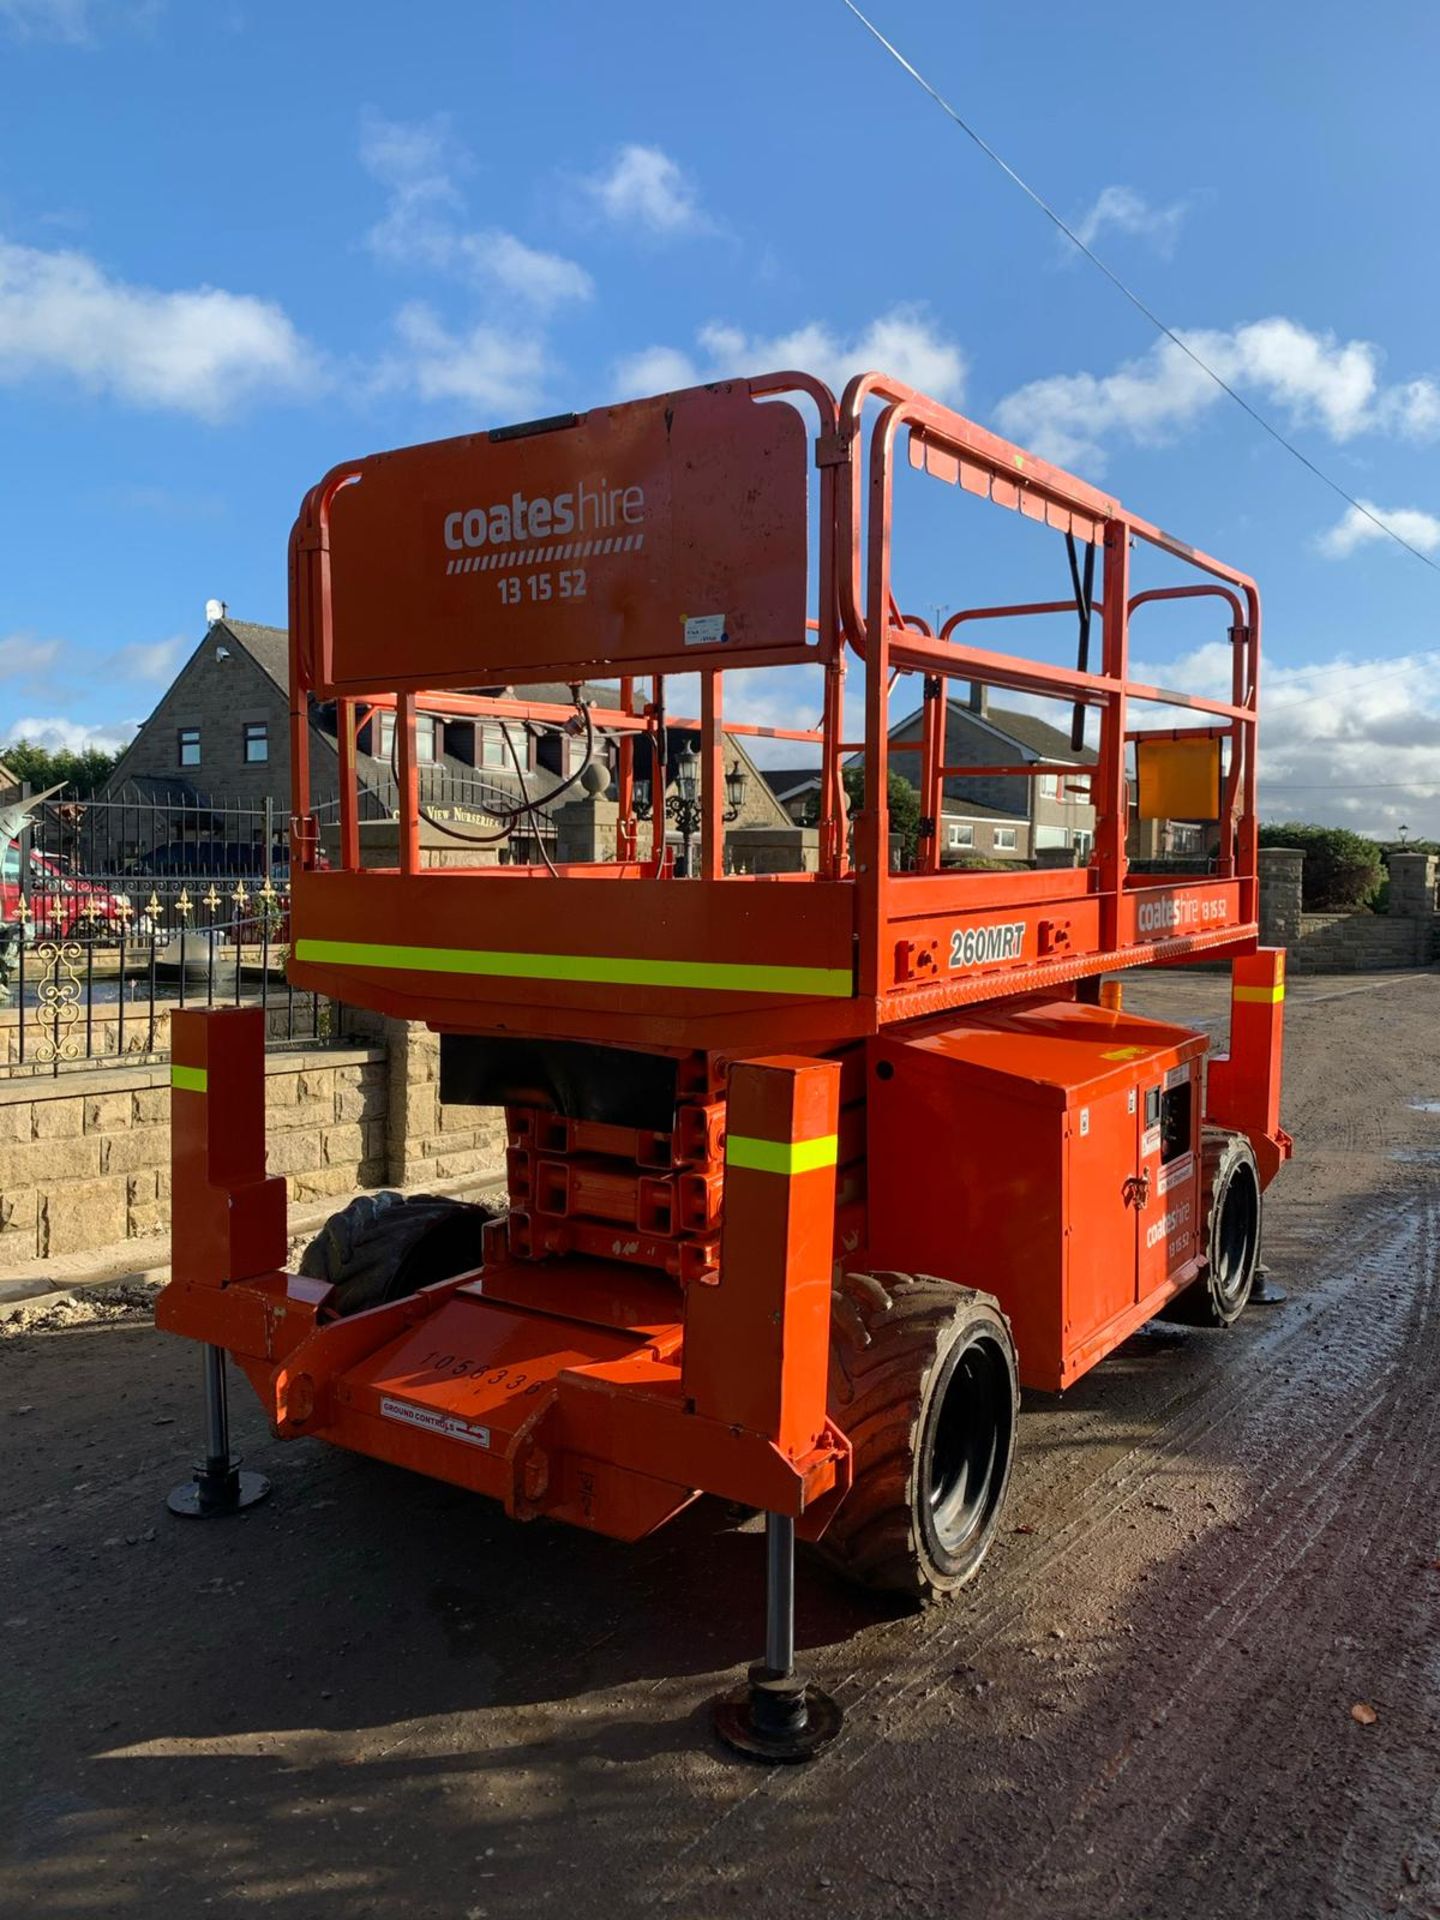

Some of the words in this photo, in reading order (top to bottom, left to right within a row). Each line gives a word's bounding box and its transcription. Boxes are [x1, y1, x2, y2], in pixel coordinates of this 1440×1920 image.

[444, 478, 645, 550] coateshire
[497, 577, 521, 604] 13
[527, 573, 552, 601] 15
[559, 568, 586, 597] 52
[1138, 894, 1199, 931] coateshire
[949, 922, 1025, 967] 260MRT
[384, 1402, 414, 1418] GROUND
[415, 1413, 455, 1432] CONTROLS
